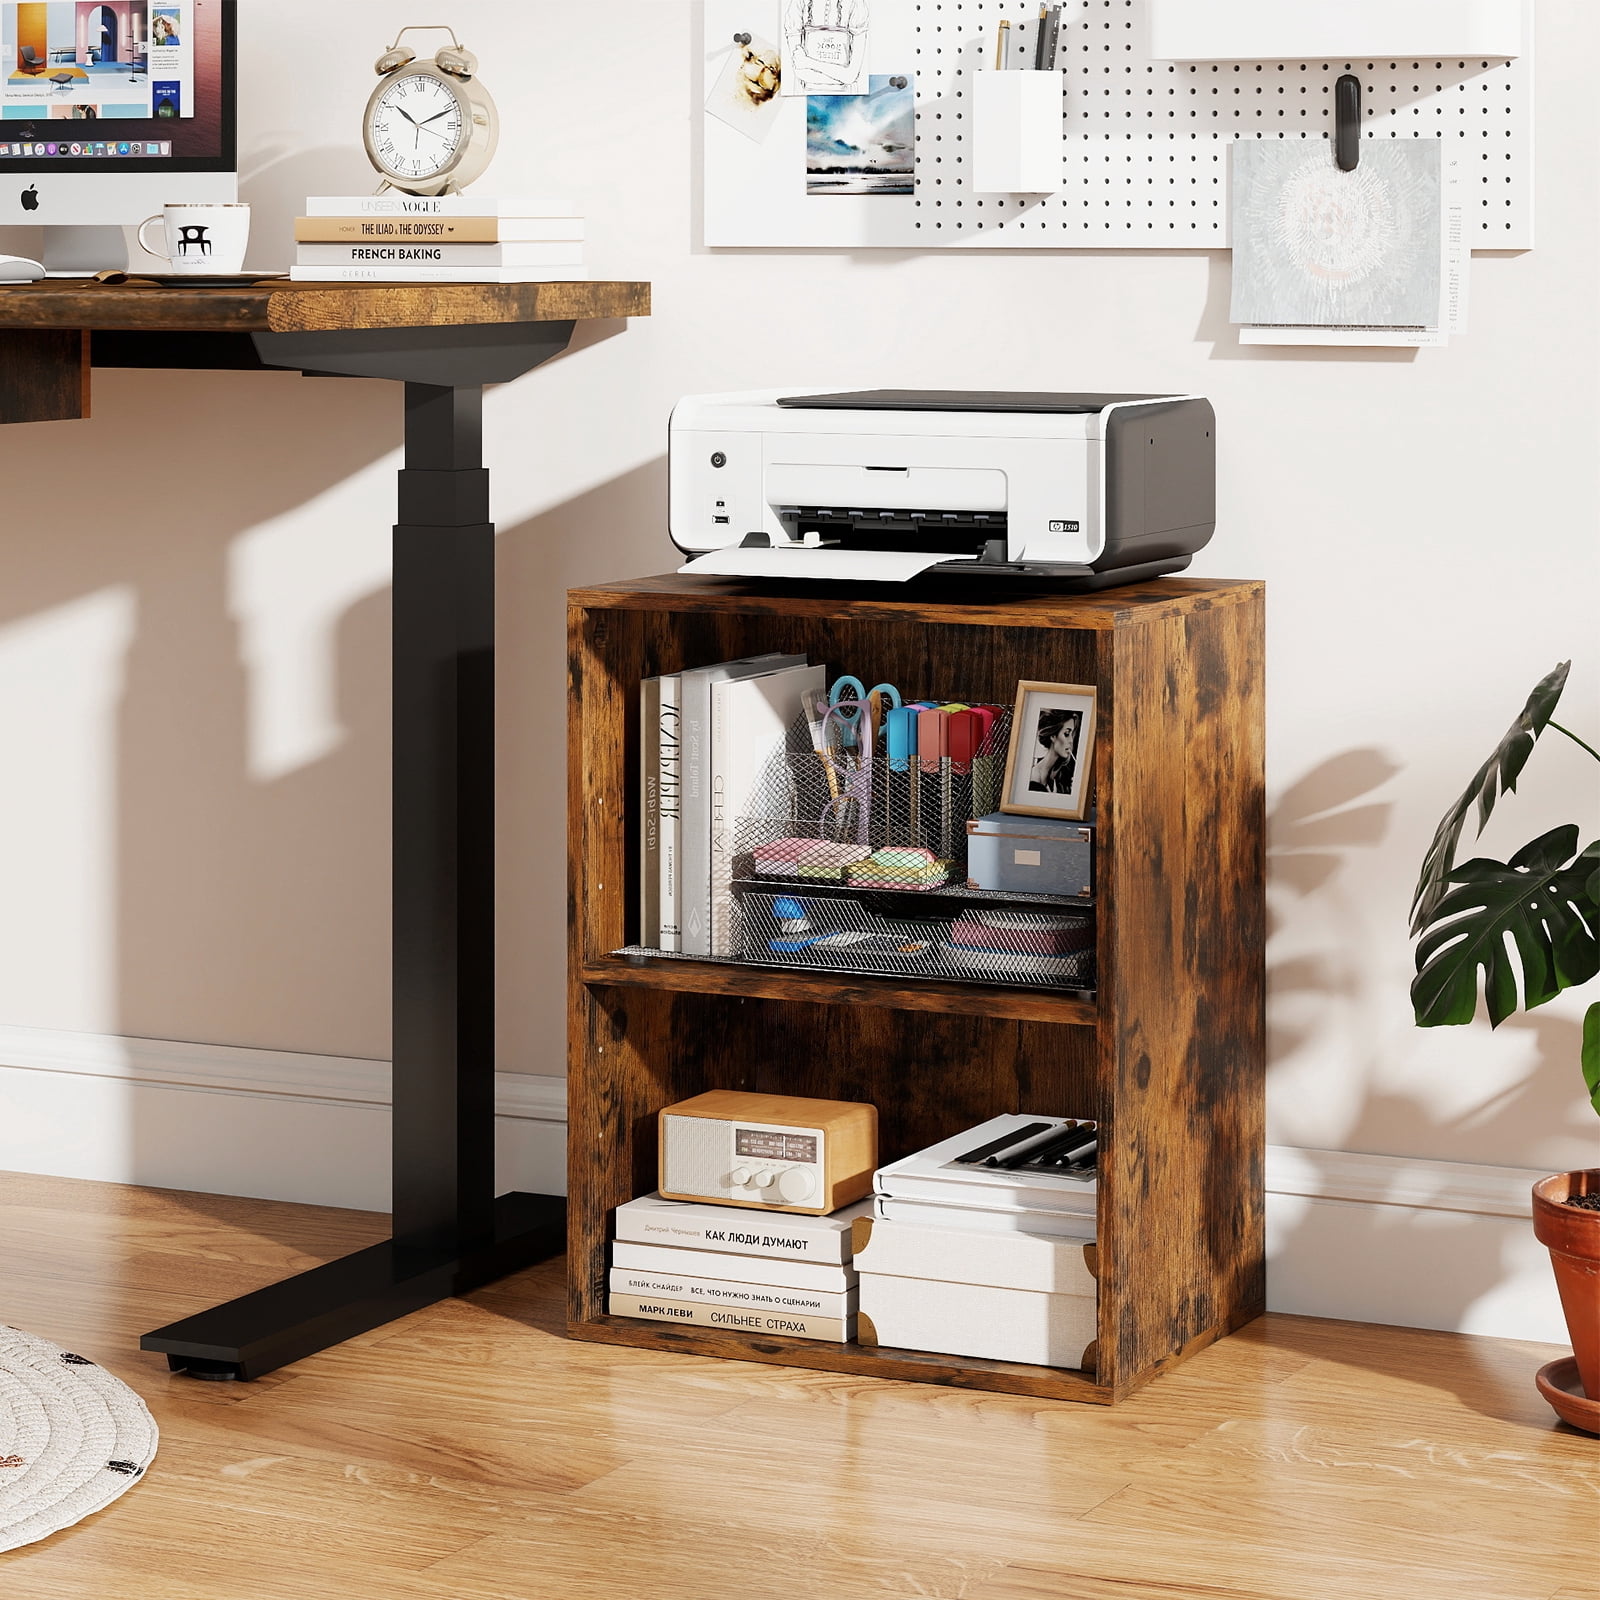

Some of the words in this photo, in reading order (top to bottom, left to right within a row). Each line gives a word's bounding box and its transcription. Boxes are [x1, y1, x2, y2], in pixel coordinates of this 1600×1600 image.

[414, 83, 425, 92] XII
[447, 121, 456, 130] III
[402, 201, 441, 213] VOGUE
[361, 223, 374, 235] THE
[375, 223, 394, 235] ILIAD
[399, 223, 412, 235] THE
[413, 223, 444, 235] ODYSSEY
[351, 248, 395, 259] FRENCH
[398, 248, 441, 260] BAKING
[644, 1224, 669, 1233] Дмитрий
[705, 1230, 725, 1241] КАК
[728, 1232, 760, 1245] ЛЮДИ
[762, 1236, 808, 1250] ДУМАЮТ
[628, 1280, 650, 1288] БЛЕЙК
[651, 1282, 683, 1292] СНАЙДЕР
[690, 1287, 705, 1295] ВСЕ,
[722, 1291, 749, 1300] НУЖНО
[751, 1294, 773, 1303] ЗНАТЬ
[782, 1297, 821, 1308] СЦЕНАРИИ
[639, 1304, 665, 1315] МАРК
[666, 1307, 693, 1318] ЛЕВИ
[710, 1312, 762, 1328] СИЛЬНЕЕ
[766, 1319, 806, 1333] СТРАХА
